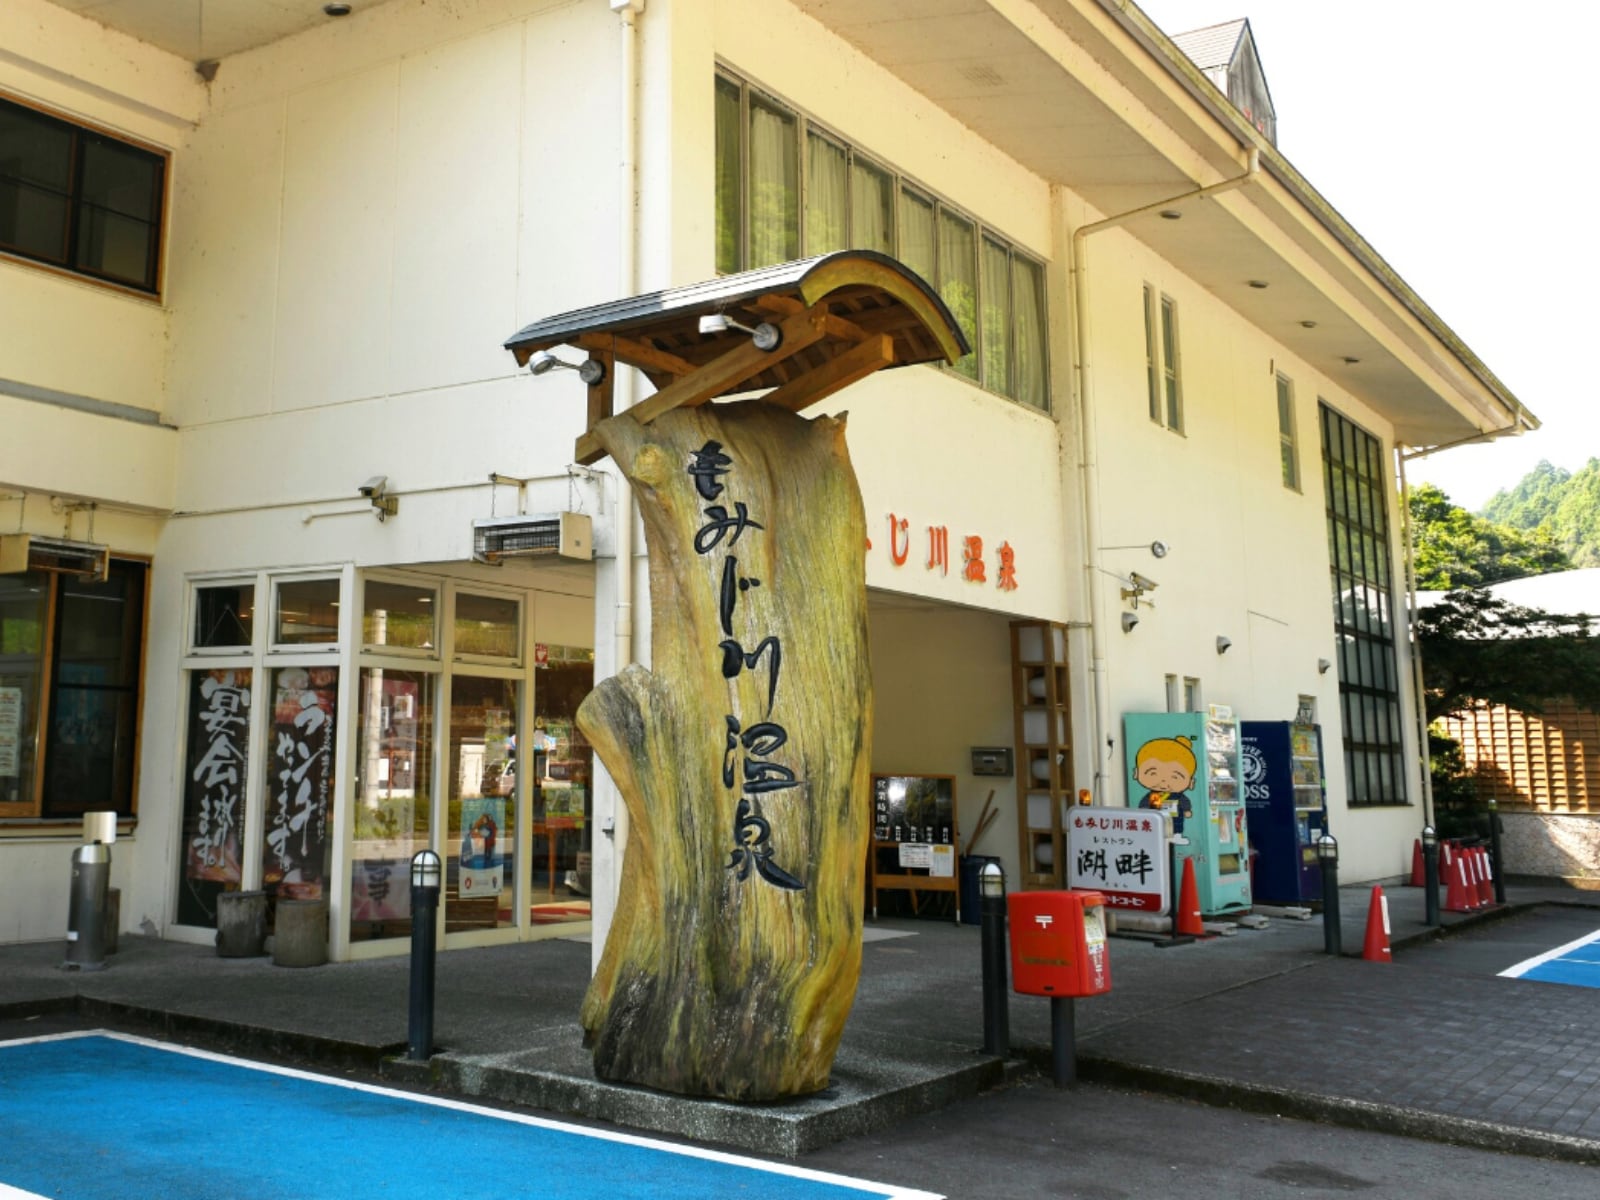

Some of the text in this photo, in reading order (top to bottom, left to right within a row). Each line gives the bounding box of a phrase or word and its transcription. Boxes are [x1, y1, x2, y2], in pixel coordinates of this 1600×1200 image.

[866, 512, 1018, 591] じ川温泉
[688, 439, 806, 891] もみじ川温泉
[289, 691, 326, 857] ランチ
[1074, 816, 1153, 833] もみじ川温泉
[1093, 836, 1134, 845] レストラン
[1077, 848, 1153, 885] 湖畔
